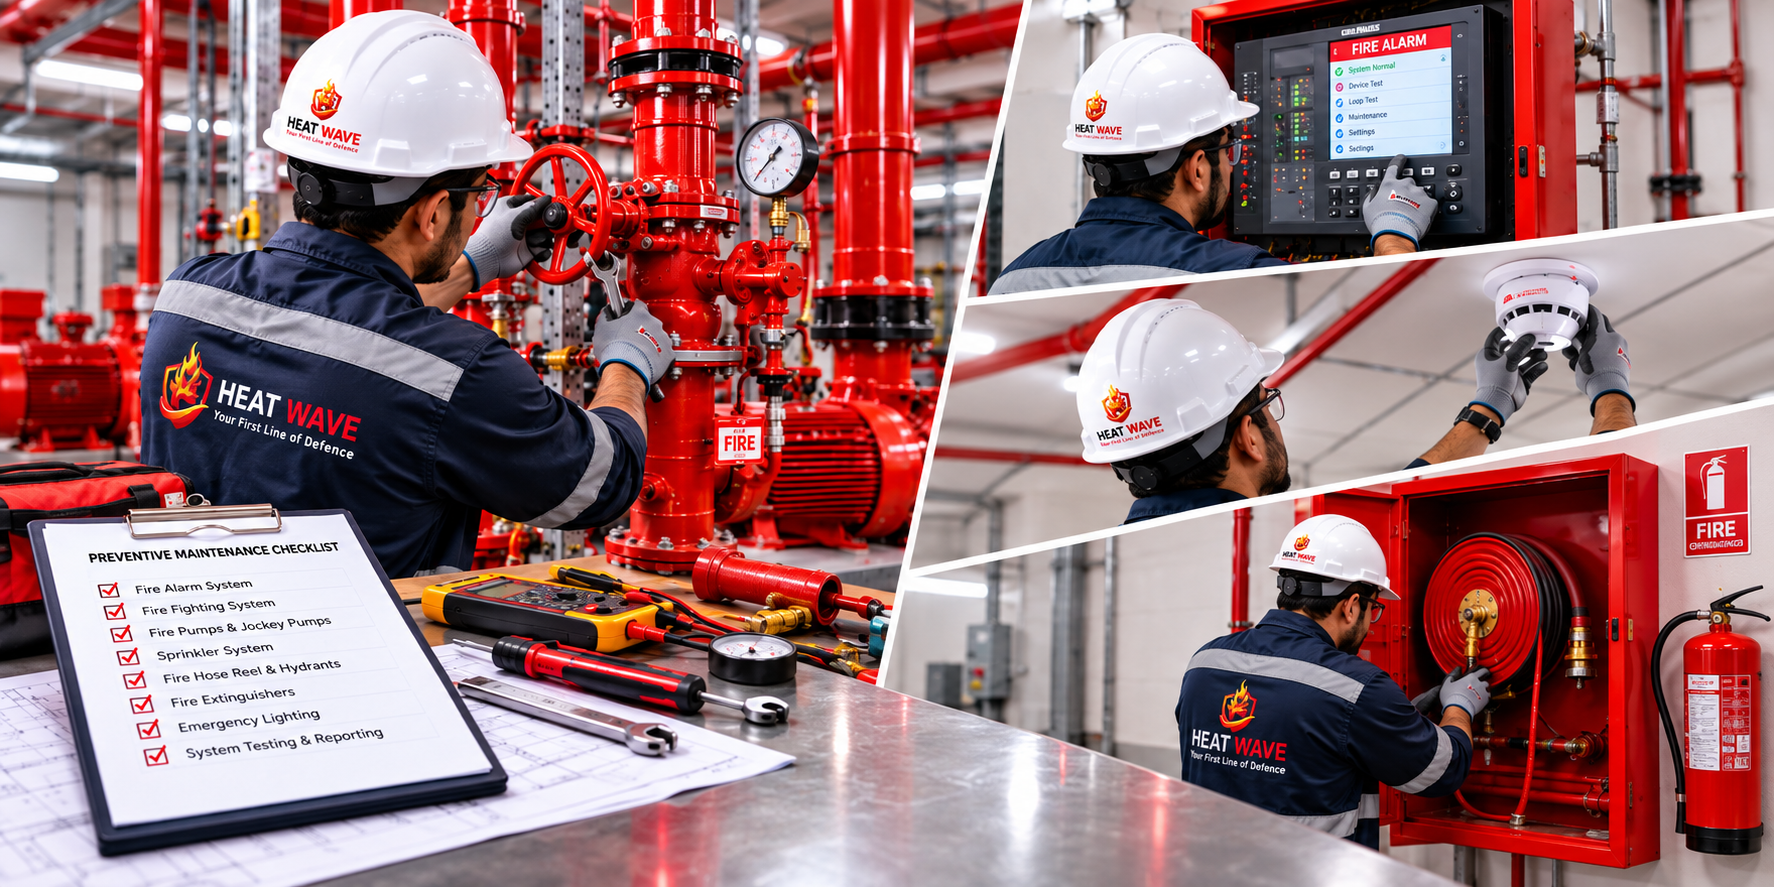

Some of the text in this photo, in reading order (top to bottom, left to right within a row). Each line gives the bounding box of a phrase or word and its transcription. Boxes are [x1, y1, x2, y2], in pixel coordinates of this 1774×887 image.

[1352, 33, 1427, 55] FIRE ALARM
[1372, 61, 1396, 71] Normal
[1349, 80, 1383, 90] Device Test
[1348, 111, 1388, 120] Maintenance
[287, 116, 361, 146] HEAT WAVE
[1075, 124, 1122, 135] HEAT WAVE
[217, 379, 361, 442] HEAT WAVE
[213, 409, 354, 460] Your First Line of Defence
[1096, 426, 1123, 441] HEAT
[1126, 416, 1162, 434] WAVE
[724, 435, 755, 452] FIRE
[1697, 520, 1736, 539] FIRE
[88, 542, 339, 563] PREVENTIVE MAINTENANCE CHECKLIST
[135, 580, 253, 595] Fire Alarm System
[142, 600, 276, 616] Fire Fighting System
[149, 616, 332, 638] Fire Pumps & Jockey Pumps
[157, 643, 274, 662] Sprinkler System
[163, 659, 342, 684] Fire Hose Reel & Hydrants
[170, 687, 296, 708] Fire Extinguishers
[178, 709, 320, 733] Emergency Lighting
[186, 727, 384, 760] System Testing & Reporting
[1192, 729, 1287, 762] HEAT WAVE
[1190, 749, 1286, 775] Your First Line of Defence
